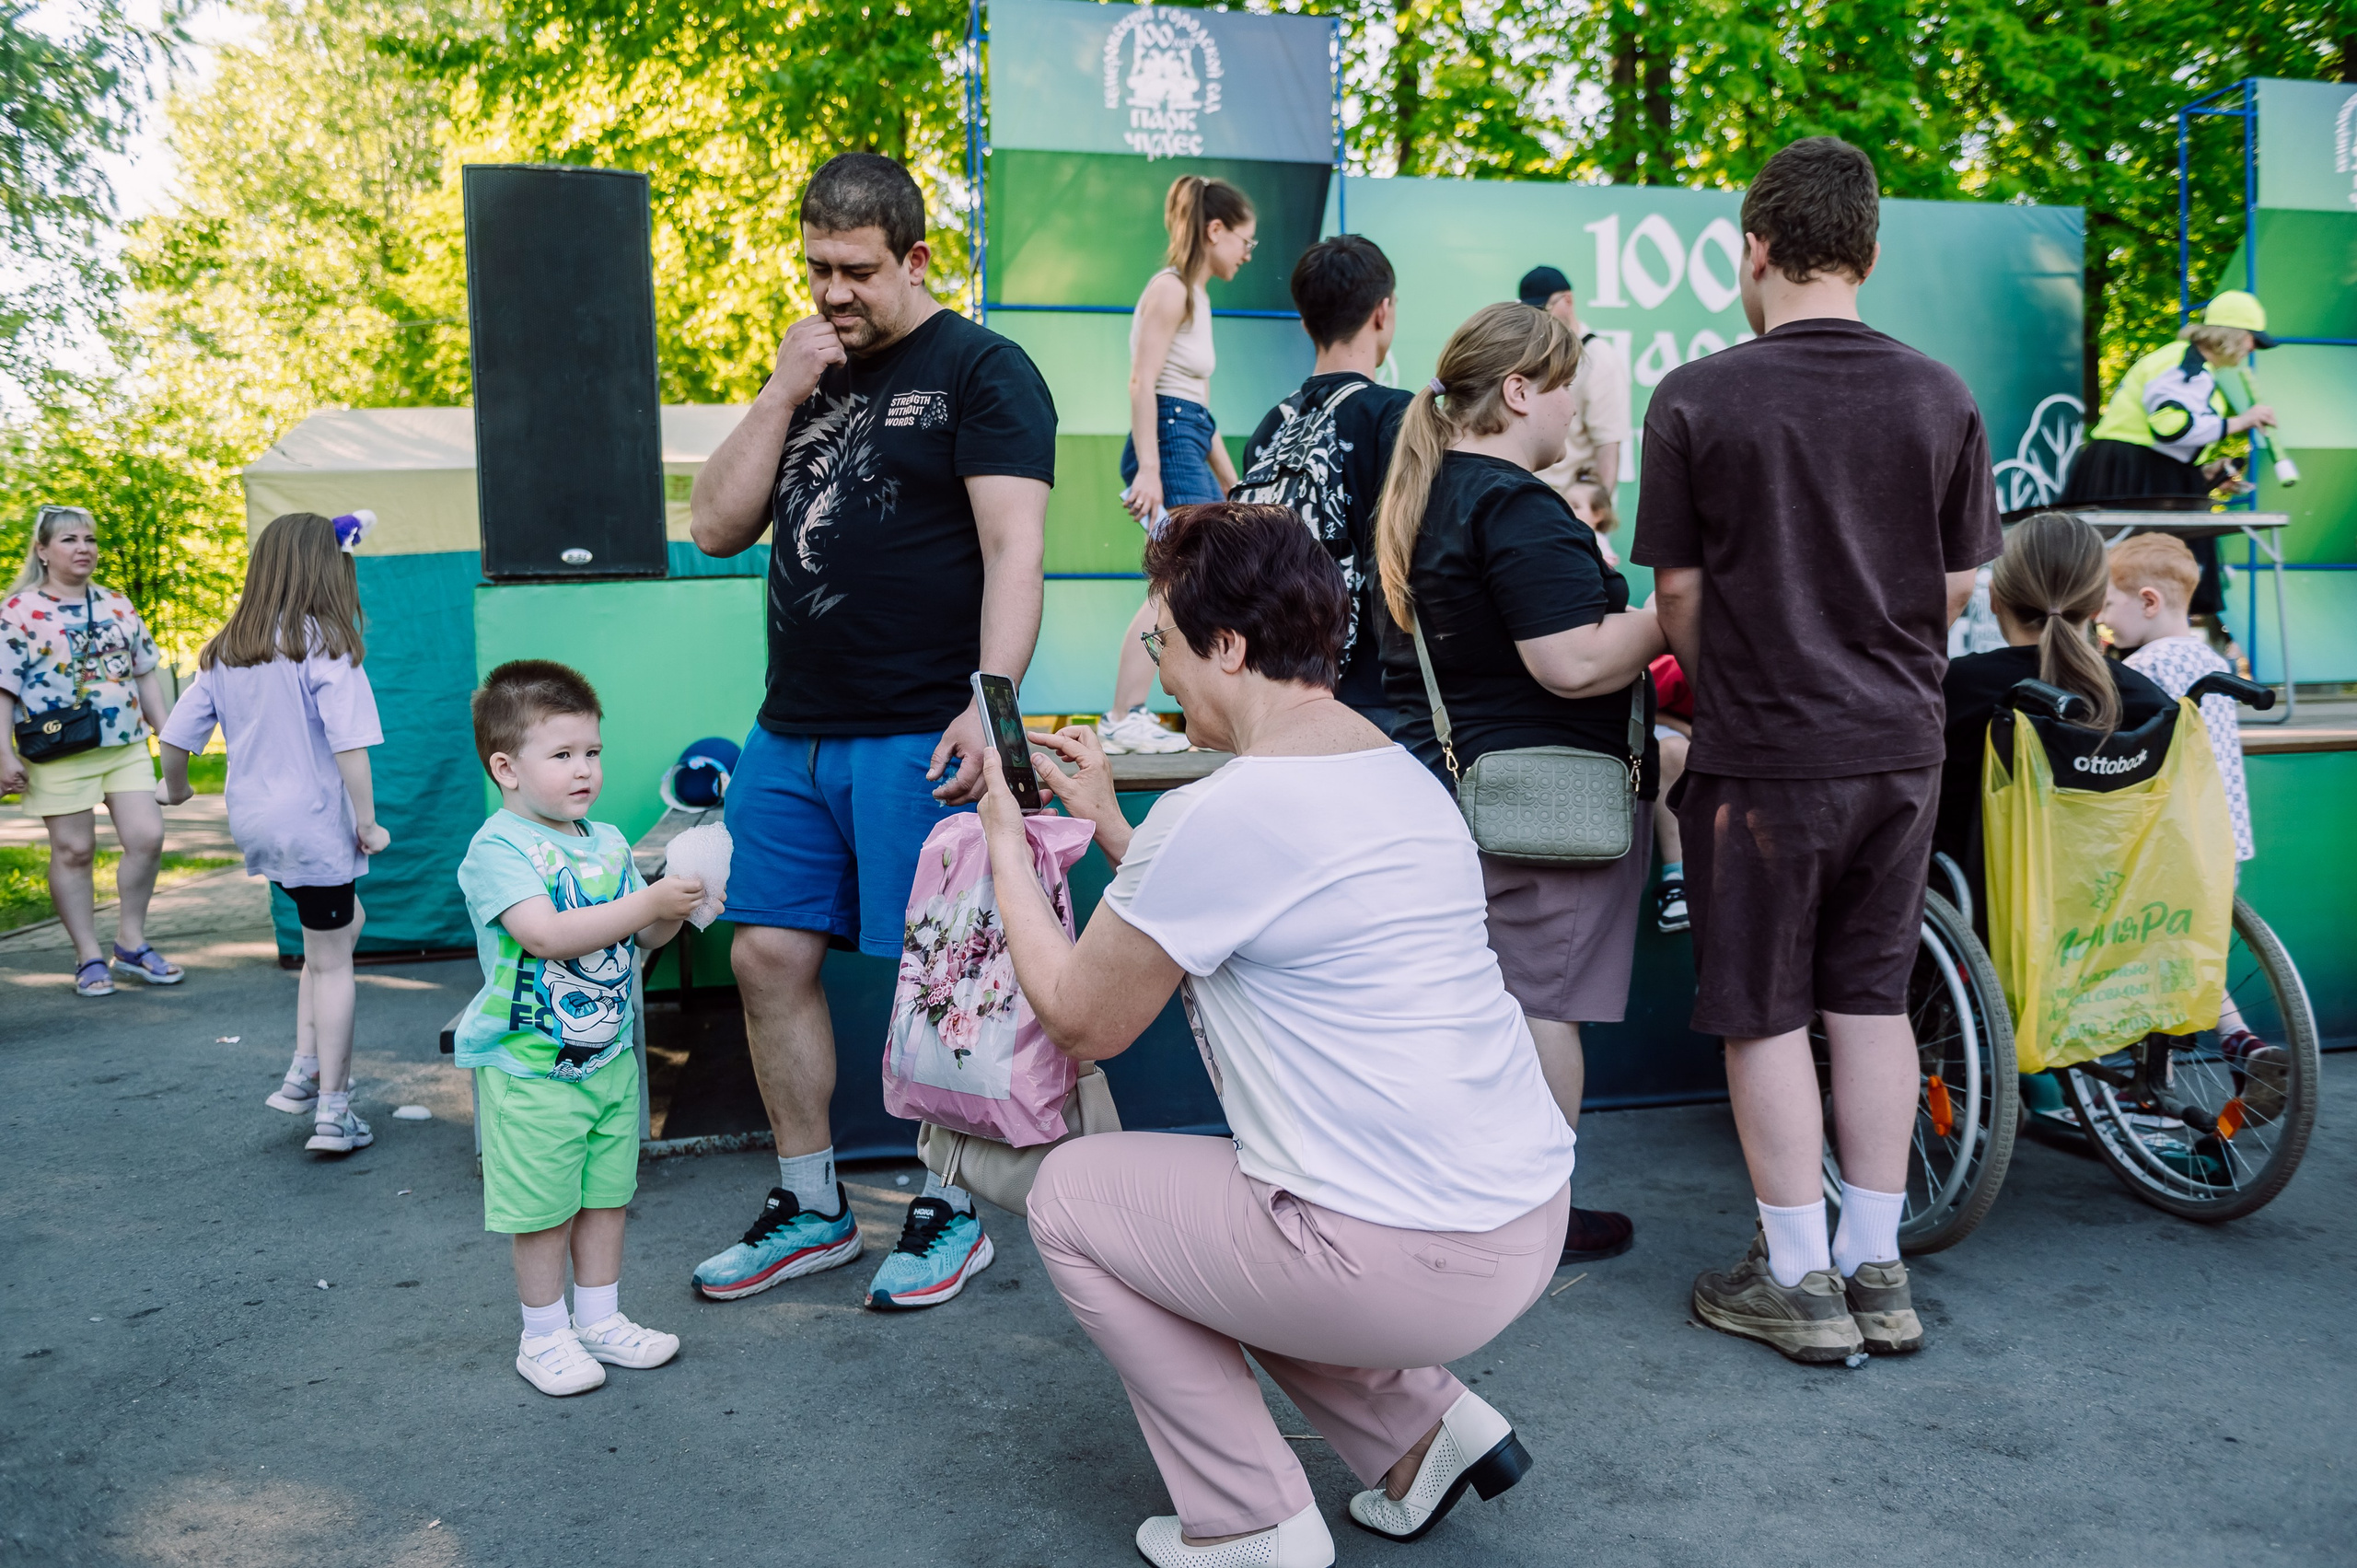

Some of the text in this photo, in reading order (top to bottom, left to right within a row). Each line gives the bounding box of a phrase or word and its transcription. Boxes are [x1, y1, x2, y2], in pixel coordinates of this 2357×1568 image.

[1584, 212, 1745, 314] 100
[890, 394, 931, 407] STRENGTH
[888, 404, 924, 417] WITHOUT
[885, 416, 915, 426] WORDS
[913, 1207, 935, 1216] HOKA
